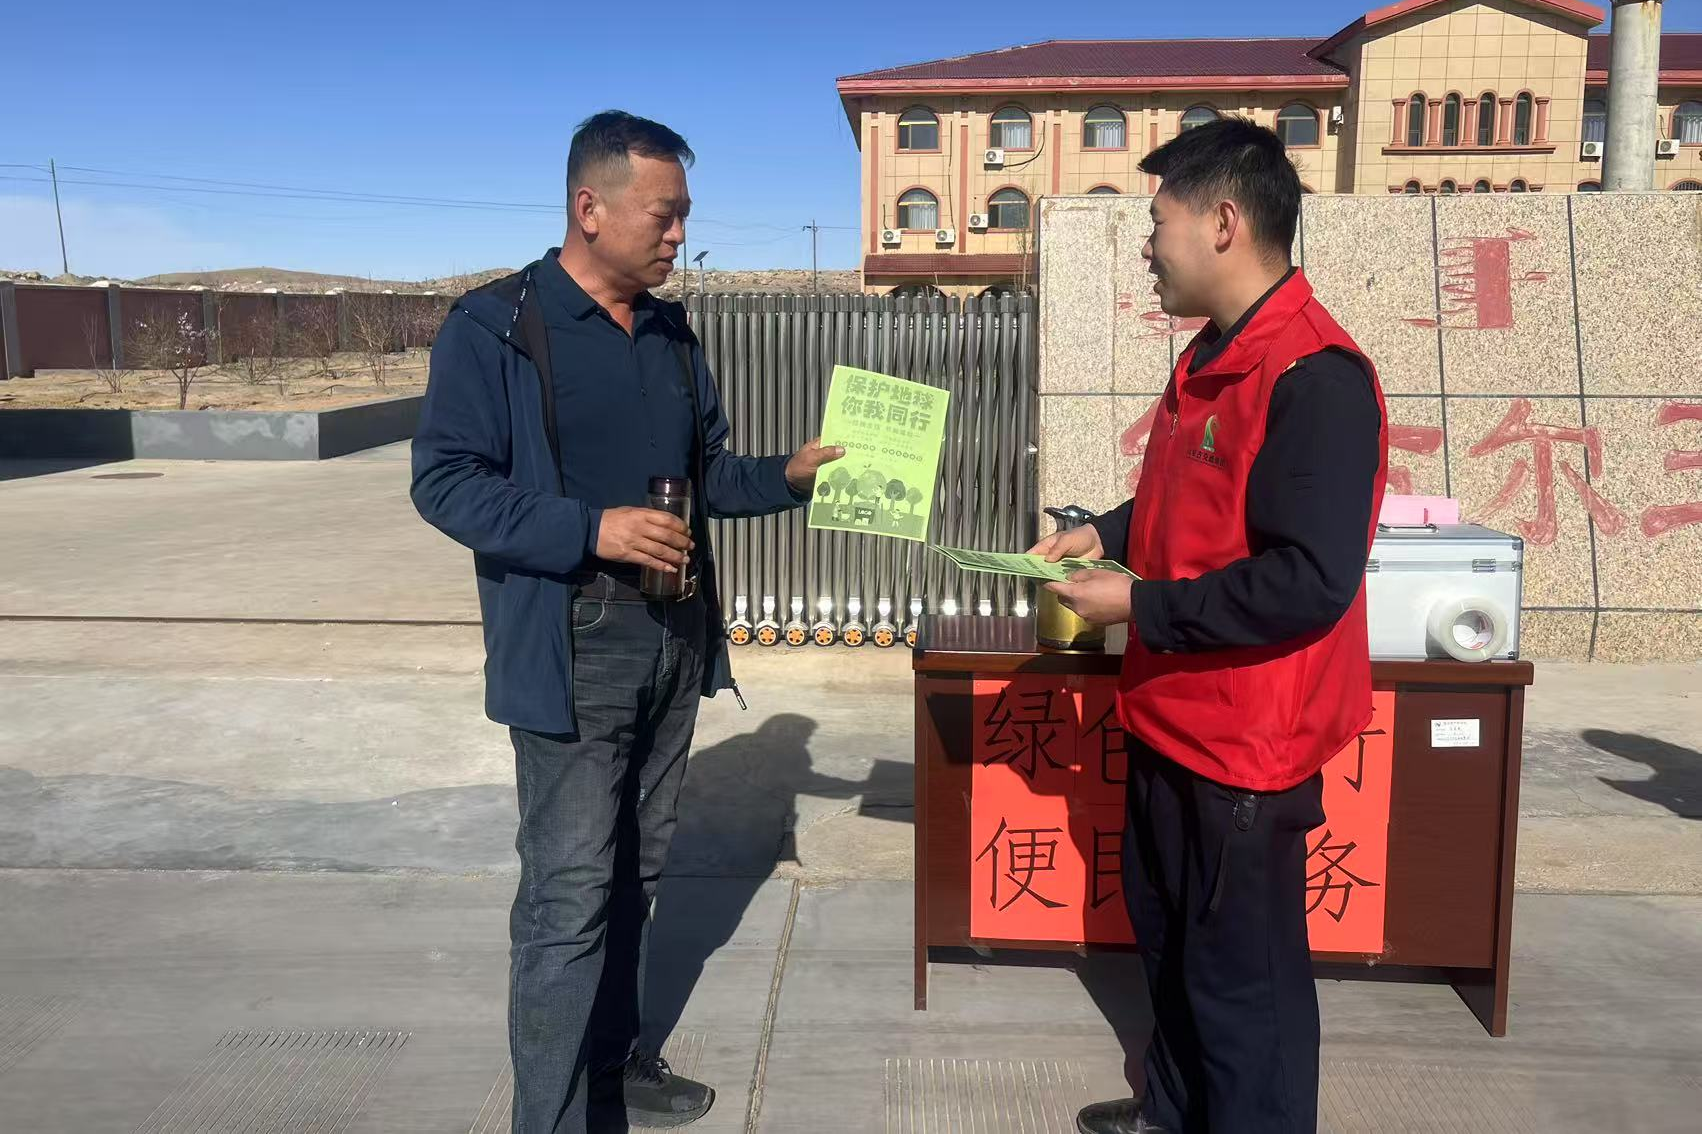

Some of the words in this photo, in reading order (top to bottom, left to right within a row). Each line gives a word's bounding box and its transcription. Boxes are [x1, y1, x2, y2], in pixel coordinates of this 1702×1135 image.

[845, 374, 935, 410] 保护地球
[841, 395, 931, 432] 你我同行
